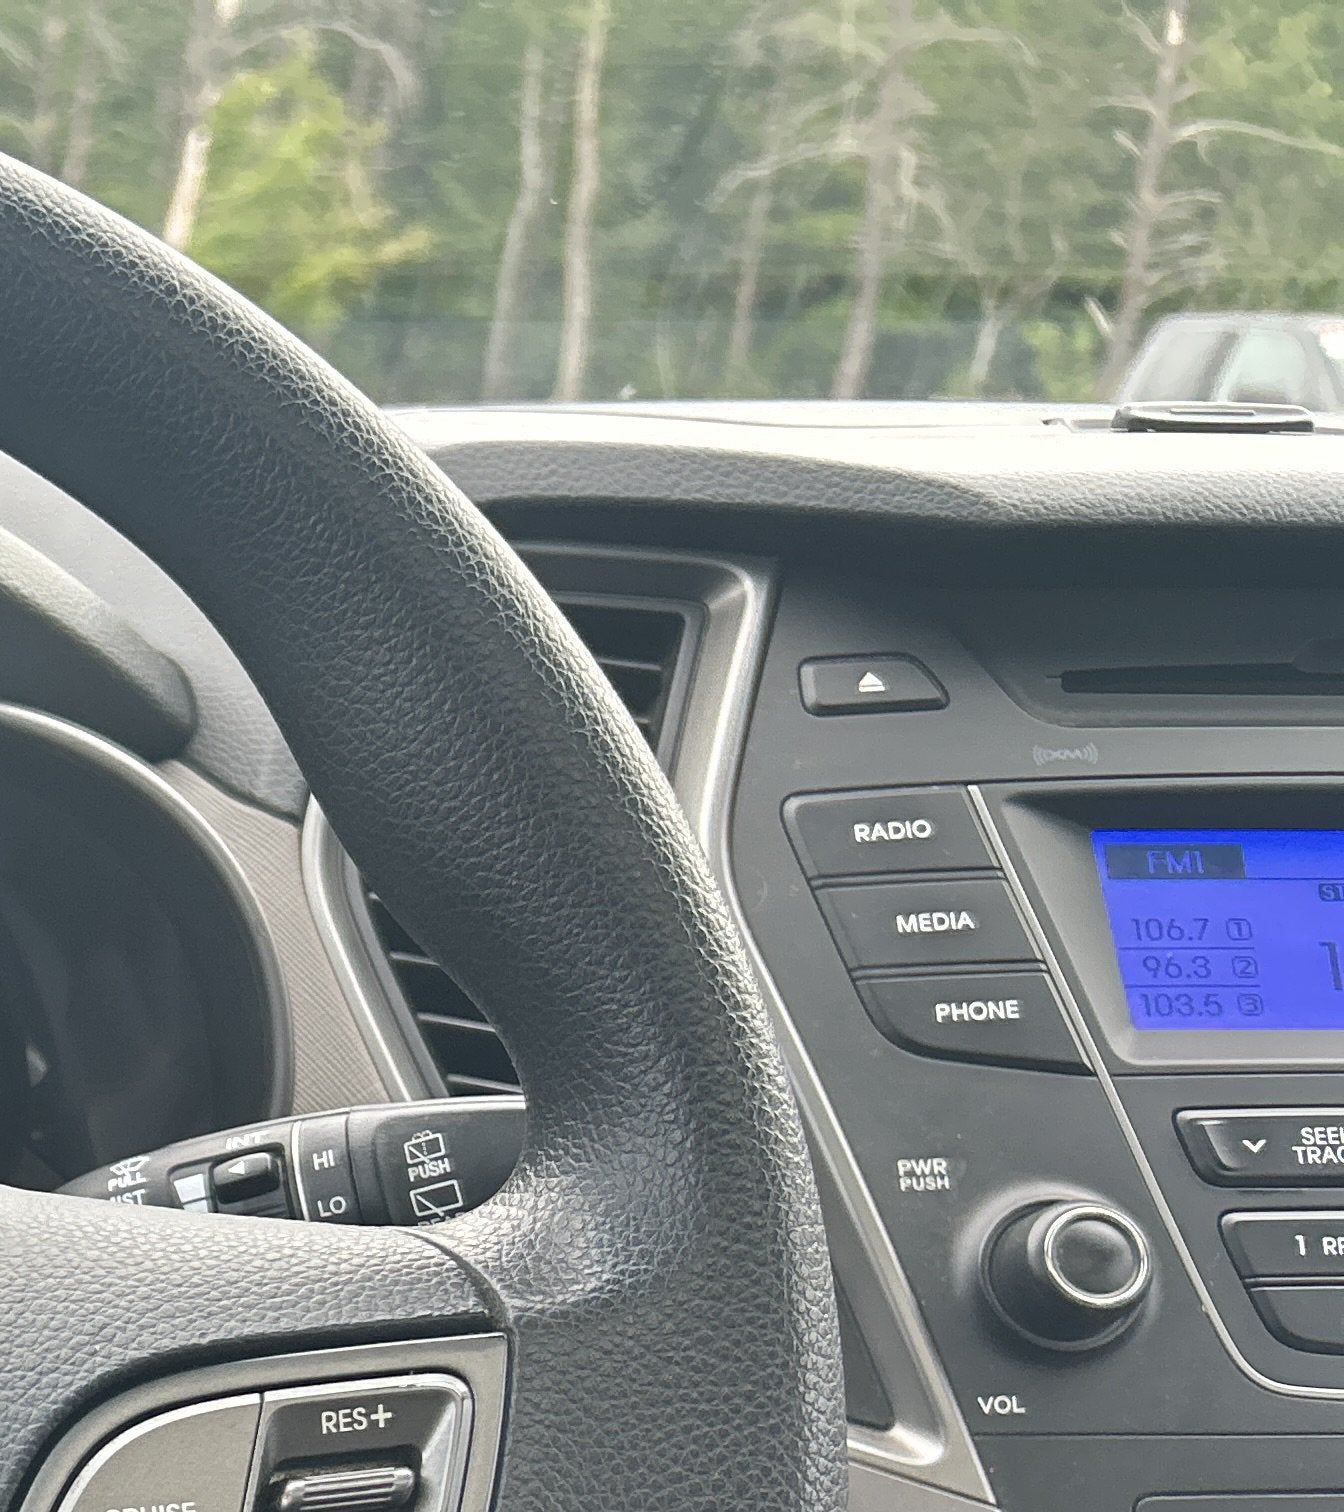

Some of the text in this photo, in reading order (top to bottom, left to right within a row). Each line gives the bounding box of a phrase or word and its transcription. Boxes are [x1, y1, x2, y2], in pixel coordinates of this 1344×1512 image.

[853, 819, 932, 843] RADIO
[1146, 850, 1205, 875] FM1
[895, 911, 976, 934] MEDIA
[1131, 918, 1210, 942] 106.7
[1142, 955, 1212, 979] 96.3
[935, 1000, 1020, 1023] PHONE
[1140, 993, 1223, 1017] 103.5
[224, 1130, 268, 1150] INT
[312, 1150, 335, 1170] HI
[407, 1157, 451, 1182] PUSH
[897, 1159, 948, 1177] PWR
[107, 1171, 147, 1192] PULL
[899, 1176, 950, 1191] PUSH
[317, 1196, 346, 1217] LO
[1295, 1234, 1306, 1256] 1
[978, 1396, 1026, 1415] VOL
